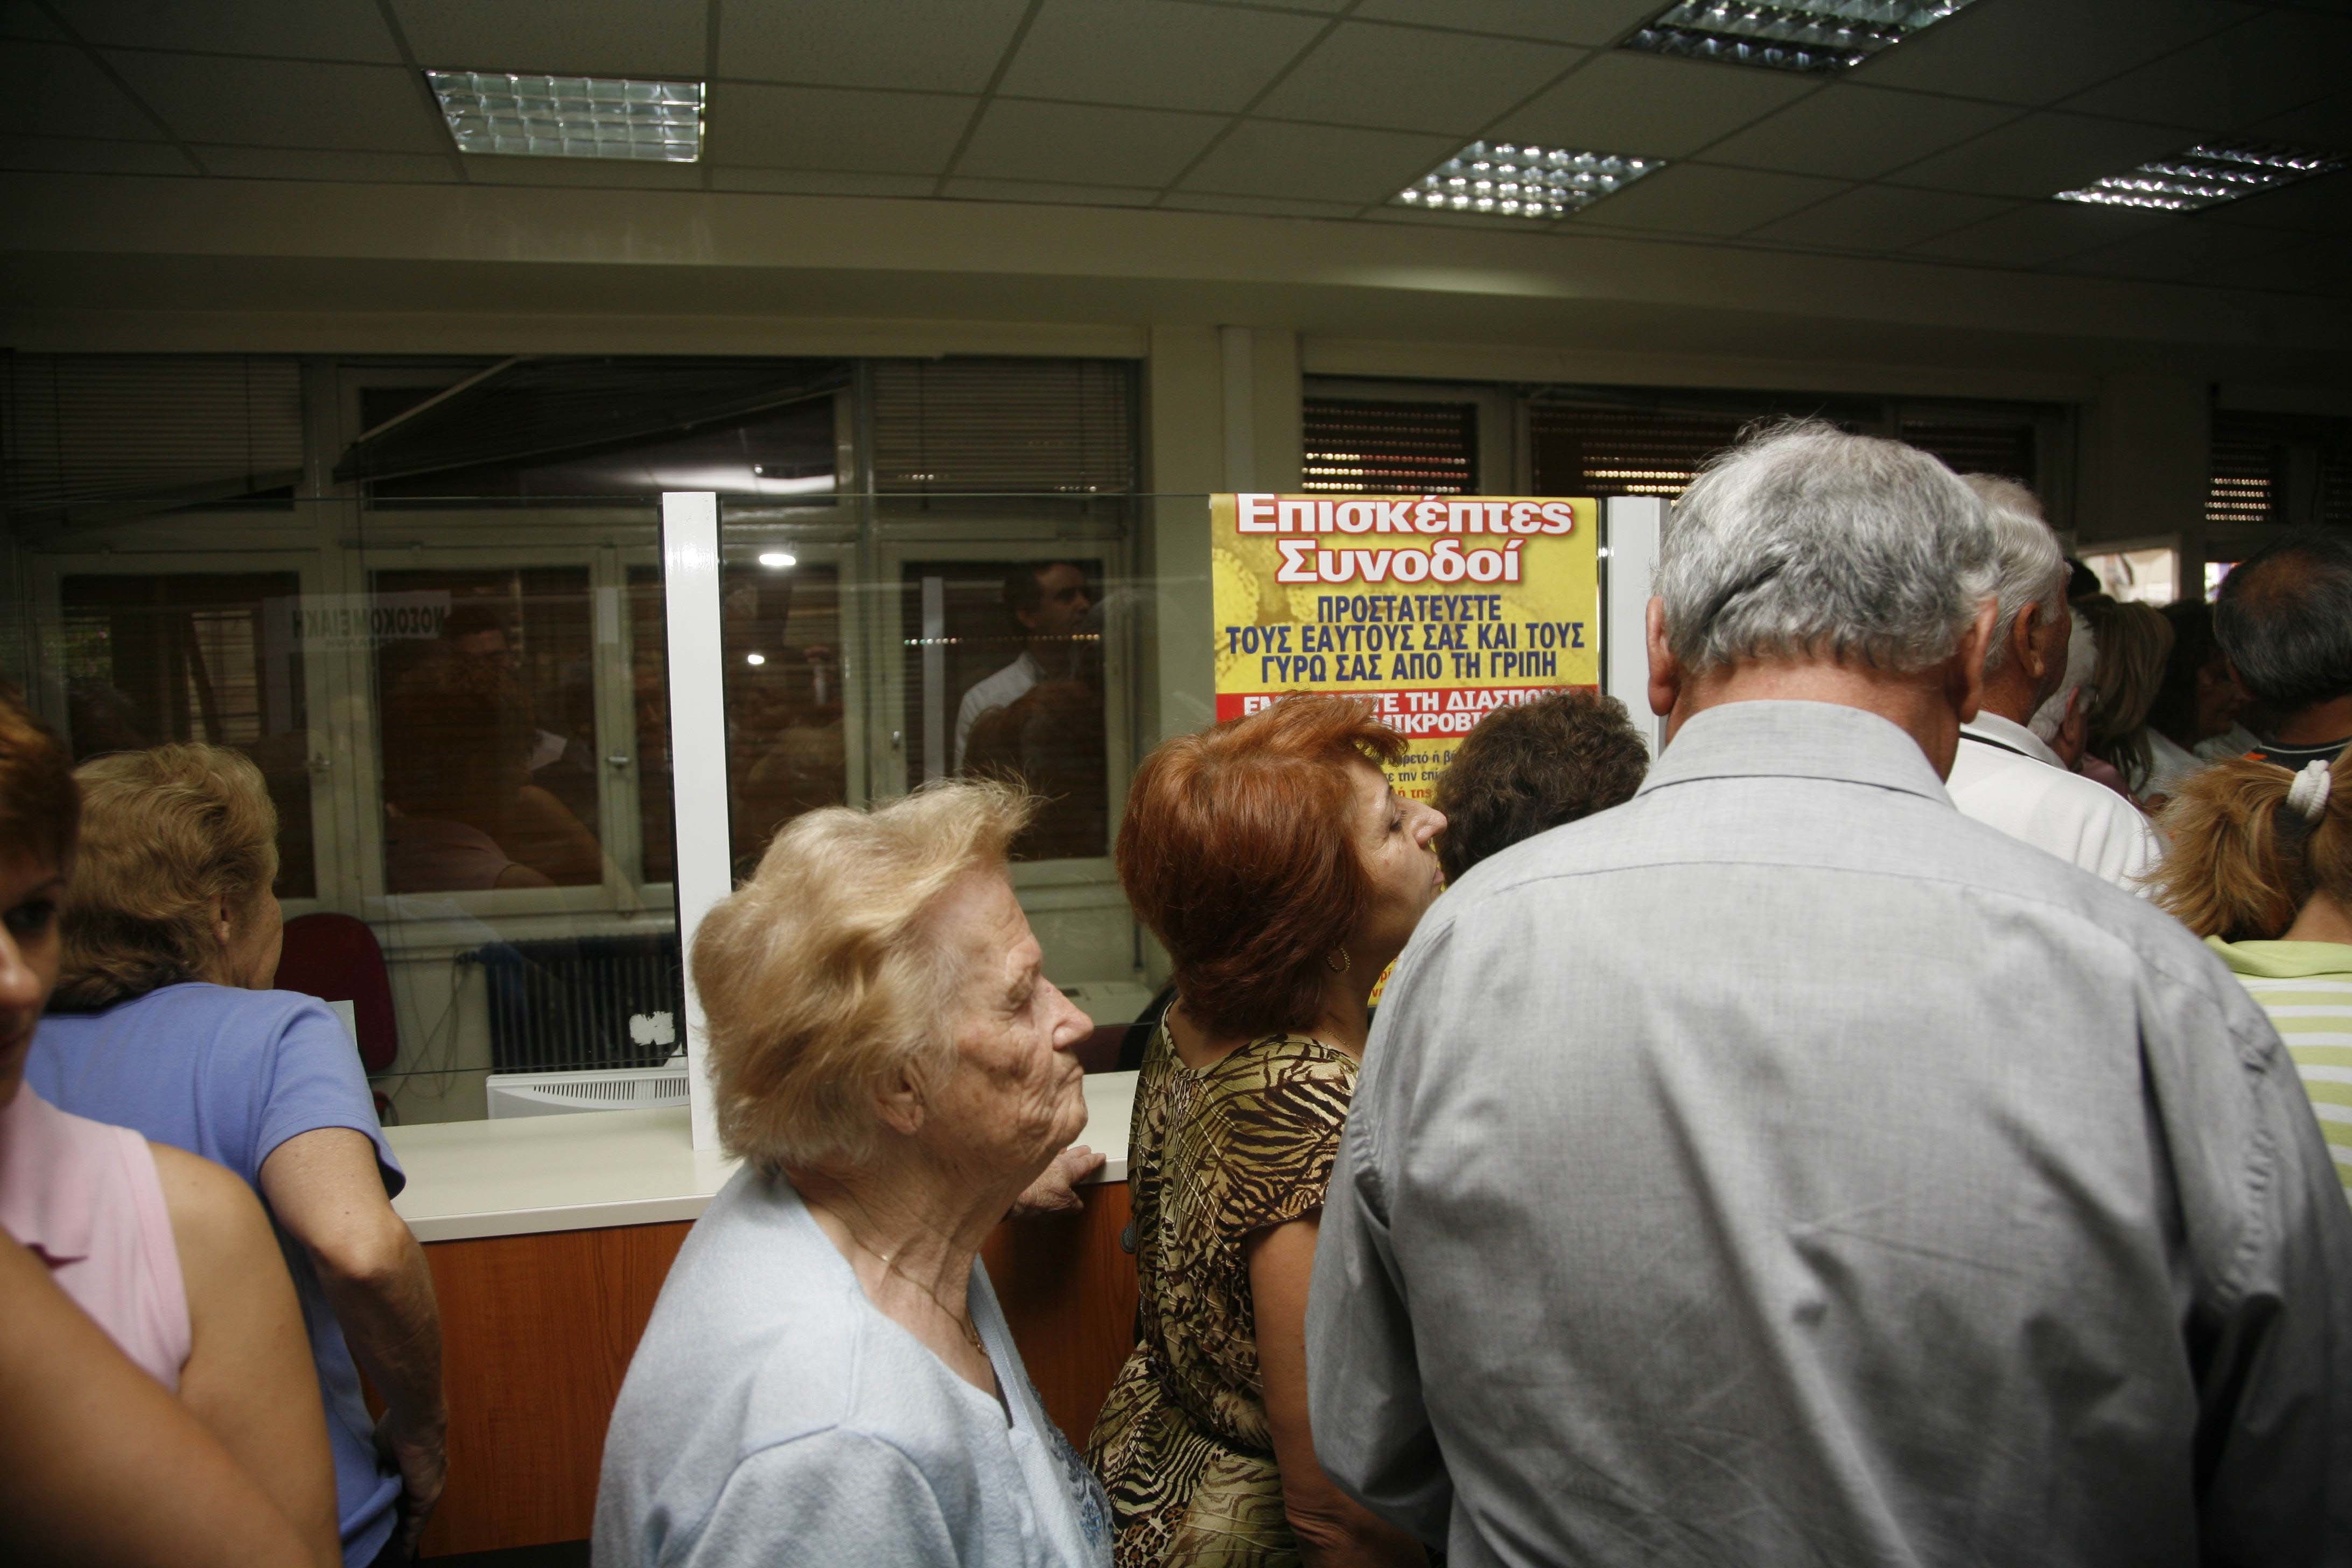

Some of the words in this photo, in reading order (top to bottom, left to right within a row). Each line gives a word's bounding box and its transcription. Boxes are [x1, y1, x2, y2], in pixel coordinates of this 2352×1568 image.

[1238, 494, 1572, 534] Επισκέπτες
[1277, 539, 1523, 583] Συνοδοί
[1318, 595, 1501, 623] ΠΡΟΣΤΑΤΕΥΣΤΕ
[1226, 627, 1292, 654] ΤΟΥΣ
[1303, 625, 1415, 653] ΕΑΥΤΟΥΣ
[1424, 624, 1468, 650] ΣΑΣ
[1478, 623, 1516, 649] ΚΑΙ
[1526, 622, 1585, 648] ΤΟΥΣ
[1262, 655, 1326, 683] ΓΥΡΩ
[1336, 654, 1382, 681] ΣΑΣ
[1392, 653, 1442, 680] ΑΠΟ
[1451, 652, 1480, 678] ΤΗ
[1491, 651, 1557, 677] ΓΡΙΠΗ
[1405, 691, 1439, 711] ΤΗ
[1398, 771, 1417, 782] την
[1410, 788, 1432, 799] της
